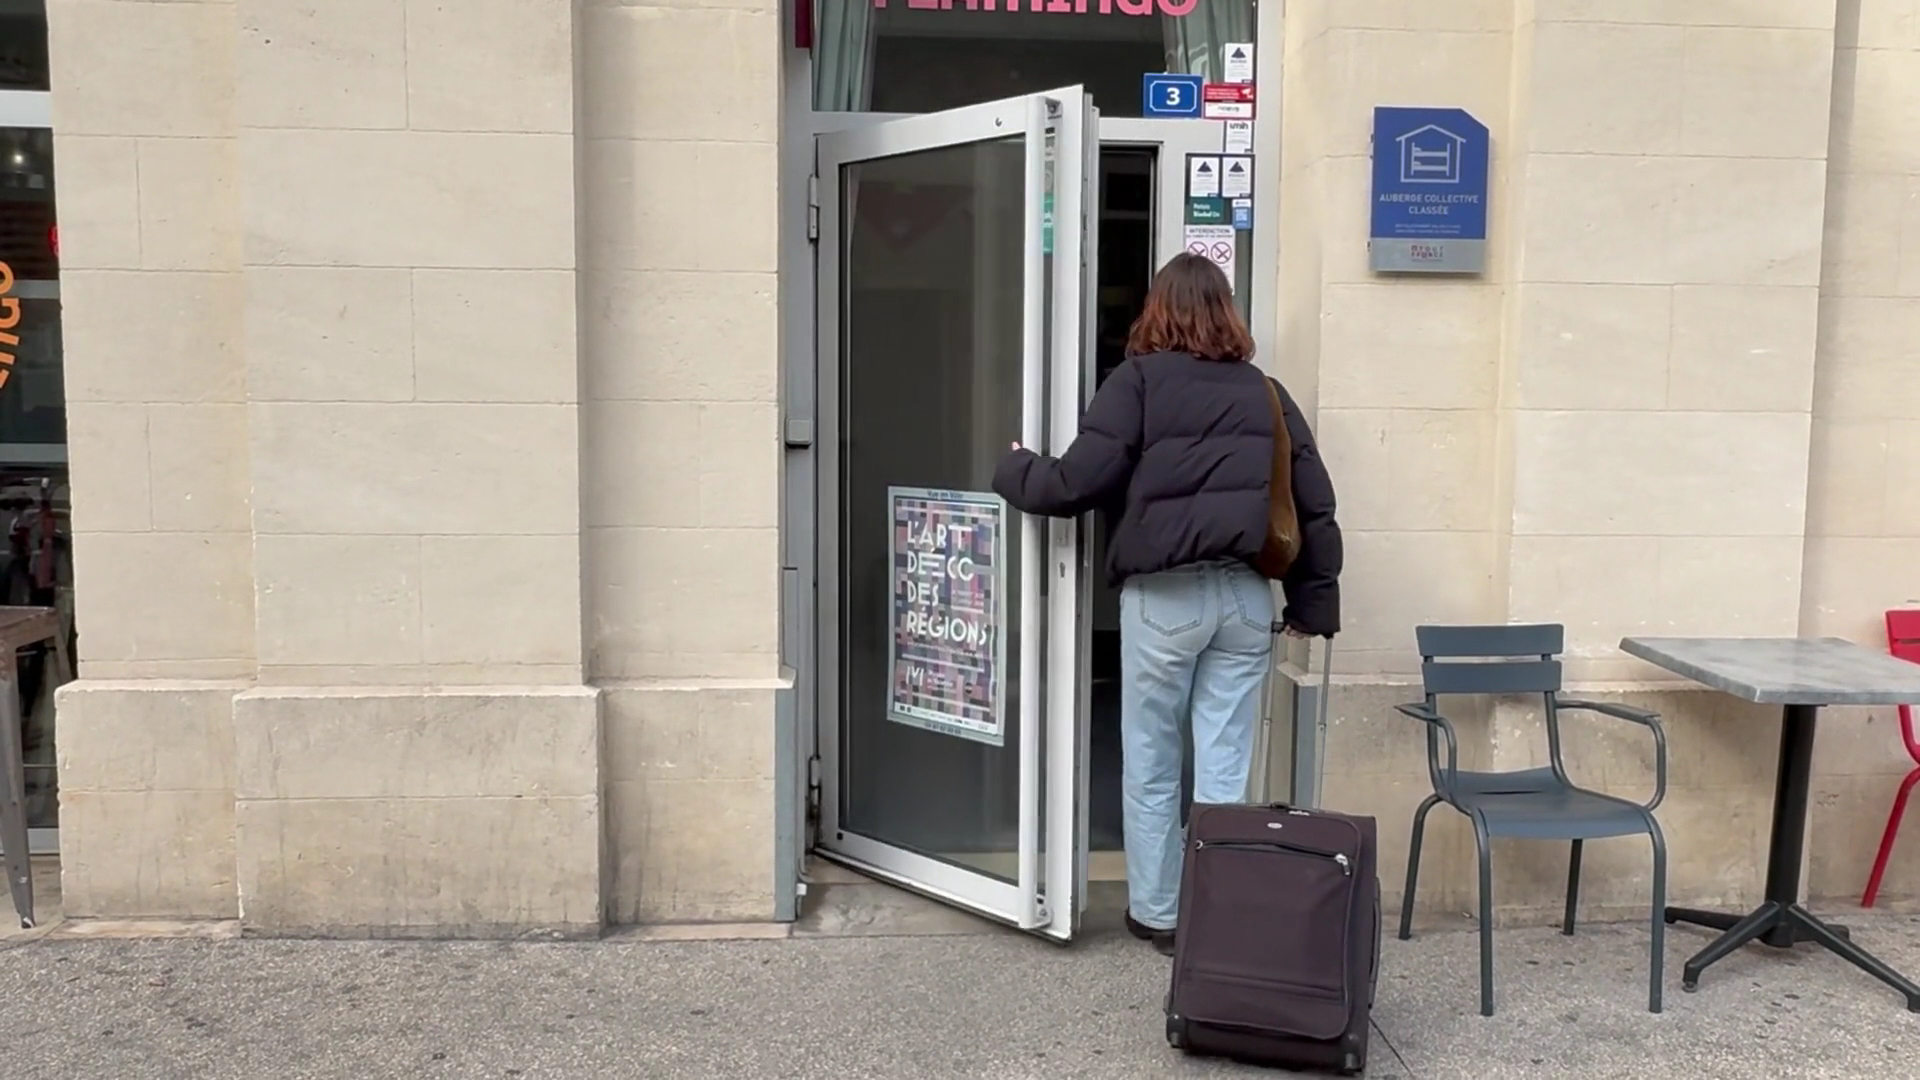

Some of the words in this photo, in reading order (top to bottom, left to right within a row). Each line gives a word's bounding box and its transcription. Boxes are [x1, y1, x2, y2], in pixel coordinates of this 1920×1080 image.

[1166, 87, 1180, 106] 3
[1379, 193, 1423, 203] AUBERGE
[1424, 194, 1479, 204] COLLECTIVE
[1408, 205, 1449, 215] CLASSÉE
[907, 520, 972, 550] L'ART
[907, 580, 938, 607] DES
[906, 605, 987, 646] RÉGIONS
